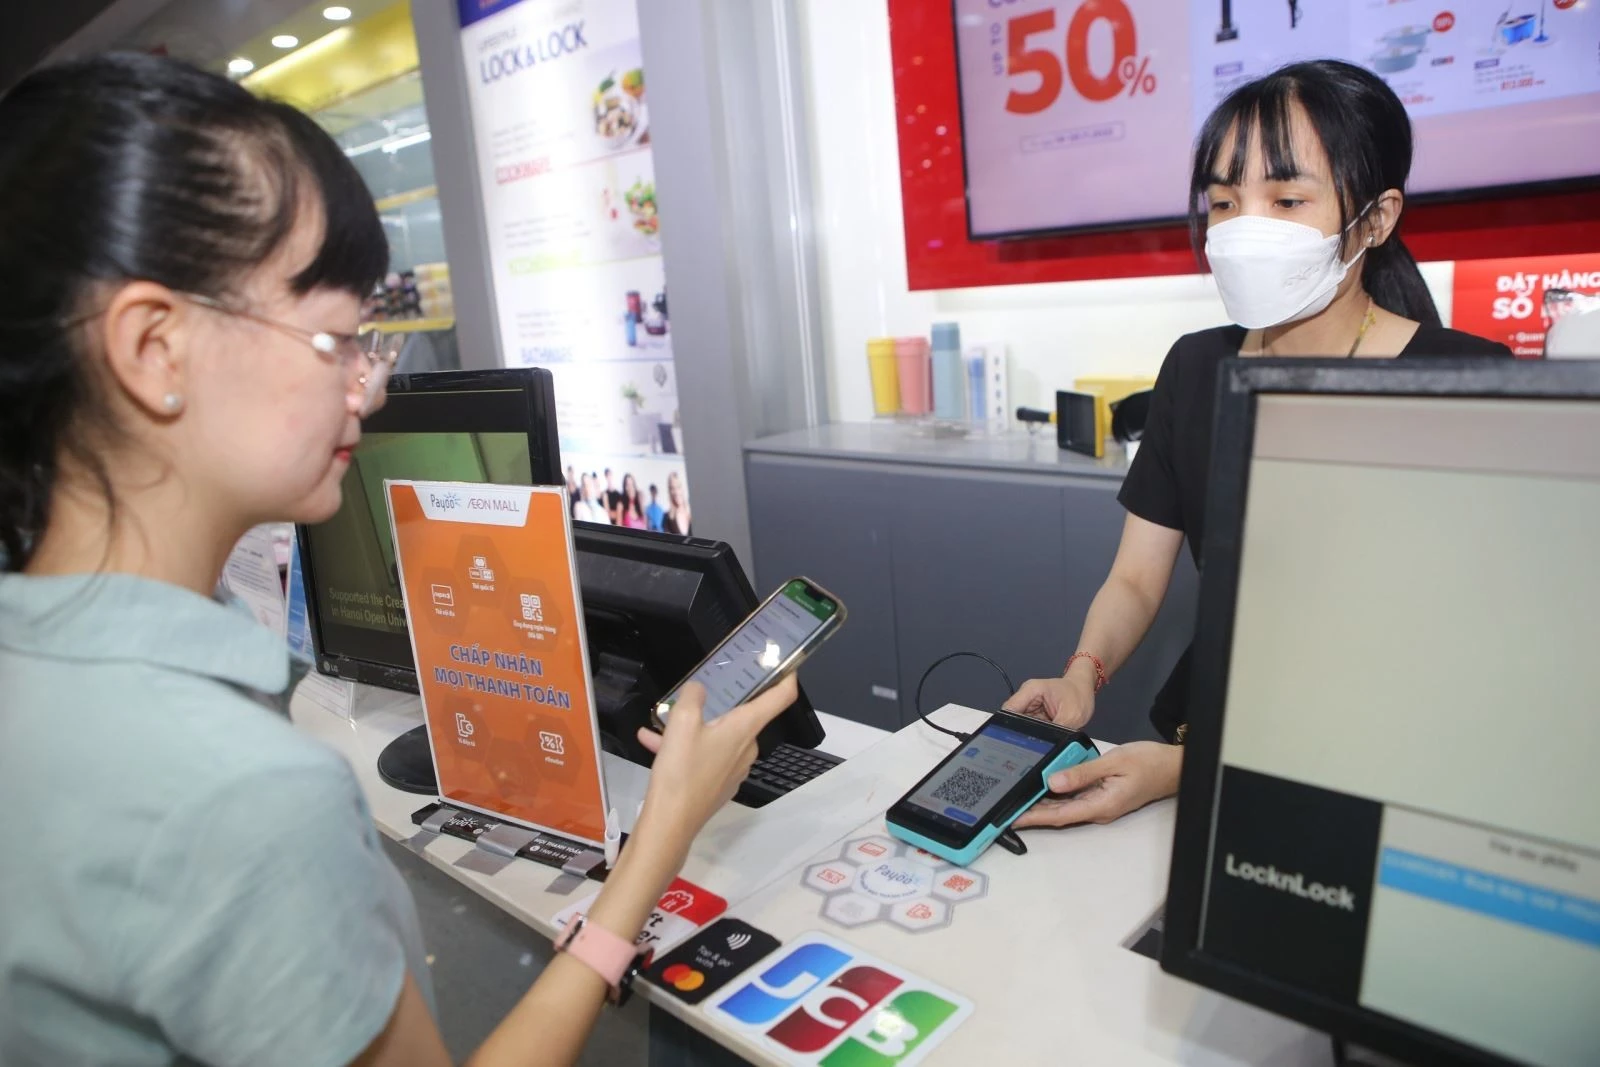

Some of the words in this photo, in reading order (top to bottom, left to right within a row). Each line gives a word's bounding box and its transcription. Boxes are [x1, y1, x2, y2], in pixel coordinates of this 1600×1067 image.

[430, 493, 455, 512] Payoo
[493, 499, 520, 512] MALL
[385, 595, 405, 610] Crea
[364, 609, 386, 625] Open
[387, 611, 408, 627] Univ
[450, 639, 490, 665] CHẤP
[494, 653, 543, 679] NHẬN
[434, 666, 464, 690] MỌI
[466, 672, 521, 699] THANH
[523, 685, 571, 710] TOÁN
[874, 863, 913, 885] Payoo
[1224, 852, 1355, 913] LocknLock
